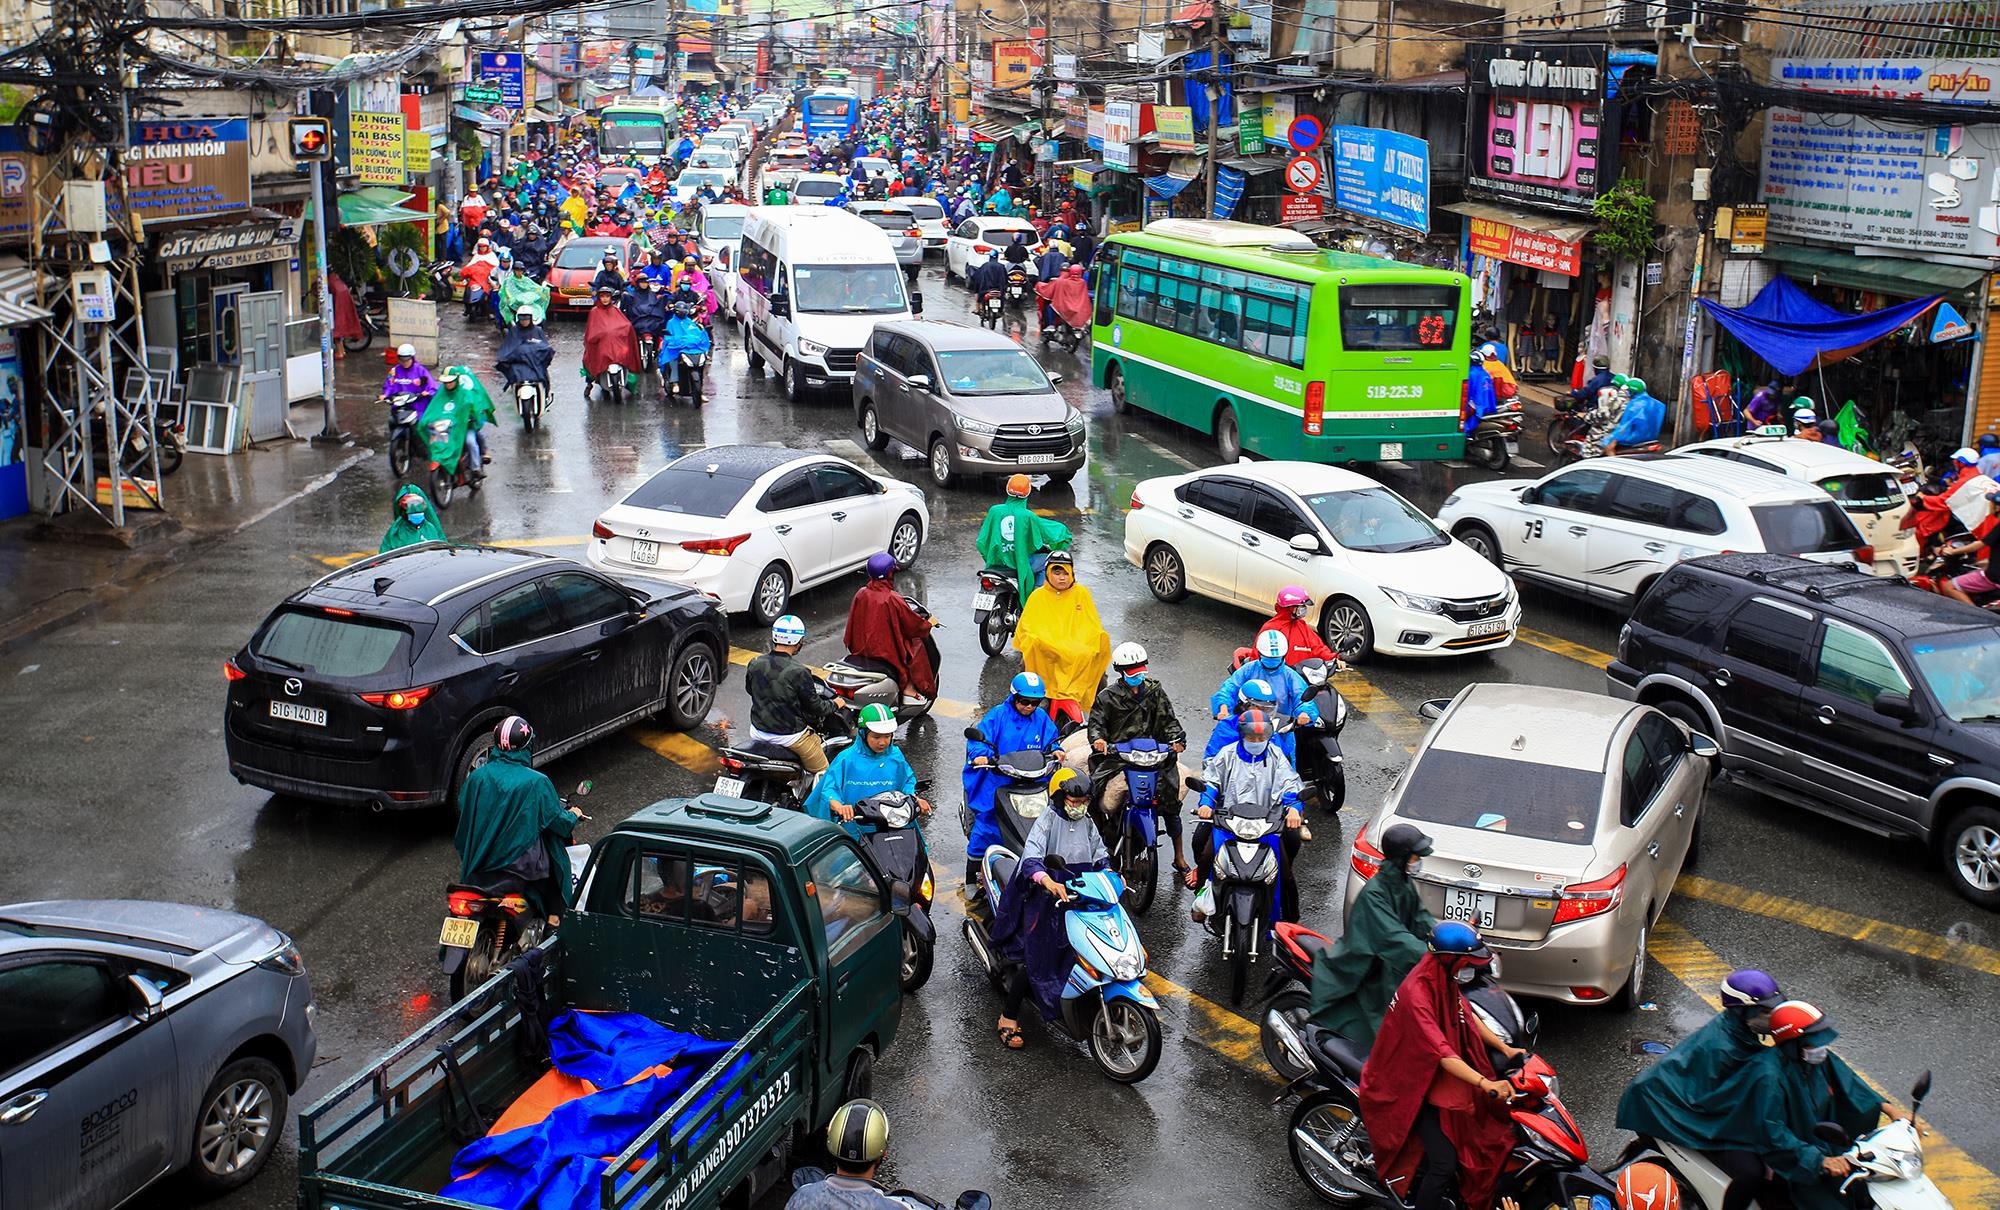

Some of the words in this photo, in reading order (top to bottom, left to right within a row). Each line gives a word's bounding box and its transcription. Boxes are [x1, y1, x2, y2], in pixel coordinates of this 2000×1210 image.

[351, 114, 368, 122] TAI
[372, 116, 401, 125] NGHE
[352, 131, 369, 139] TAI
[372, 132, 401, 141] BASS
[1514, 102, 1573, 179] LED
[145, 142, 182, 159] KÍNH
[184, 140, 226, 157] NHÔM
[365, 165, 401, 174] BLUETOOTH
[1367, 385, 1424, 399] 51B-225.39
